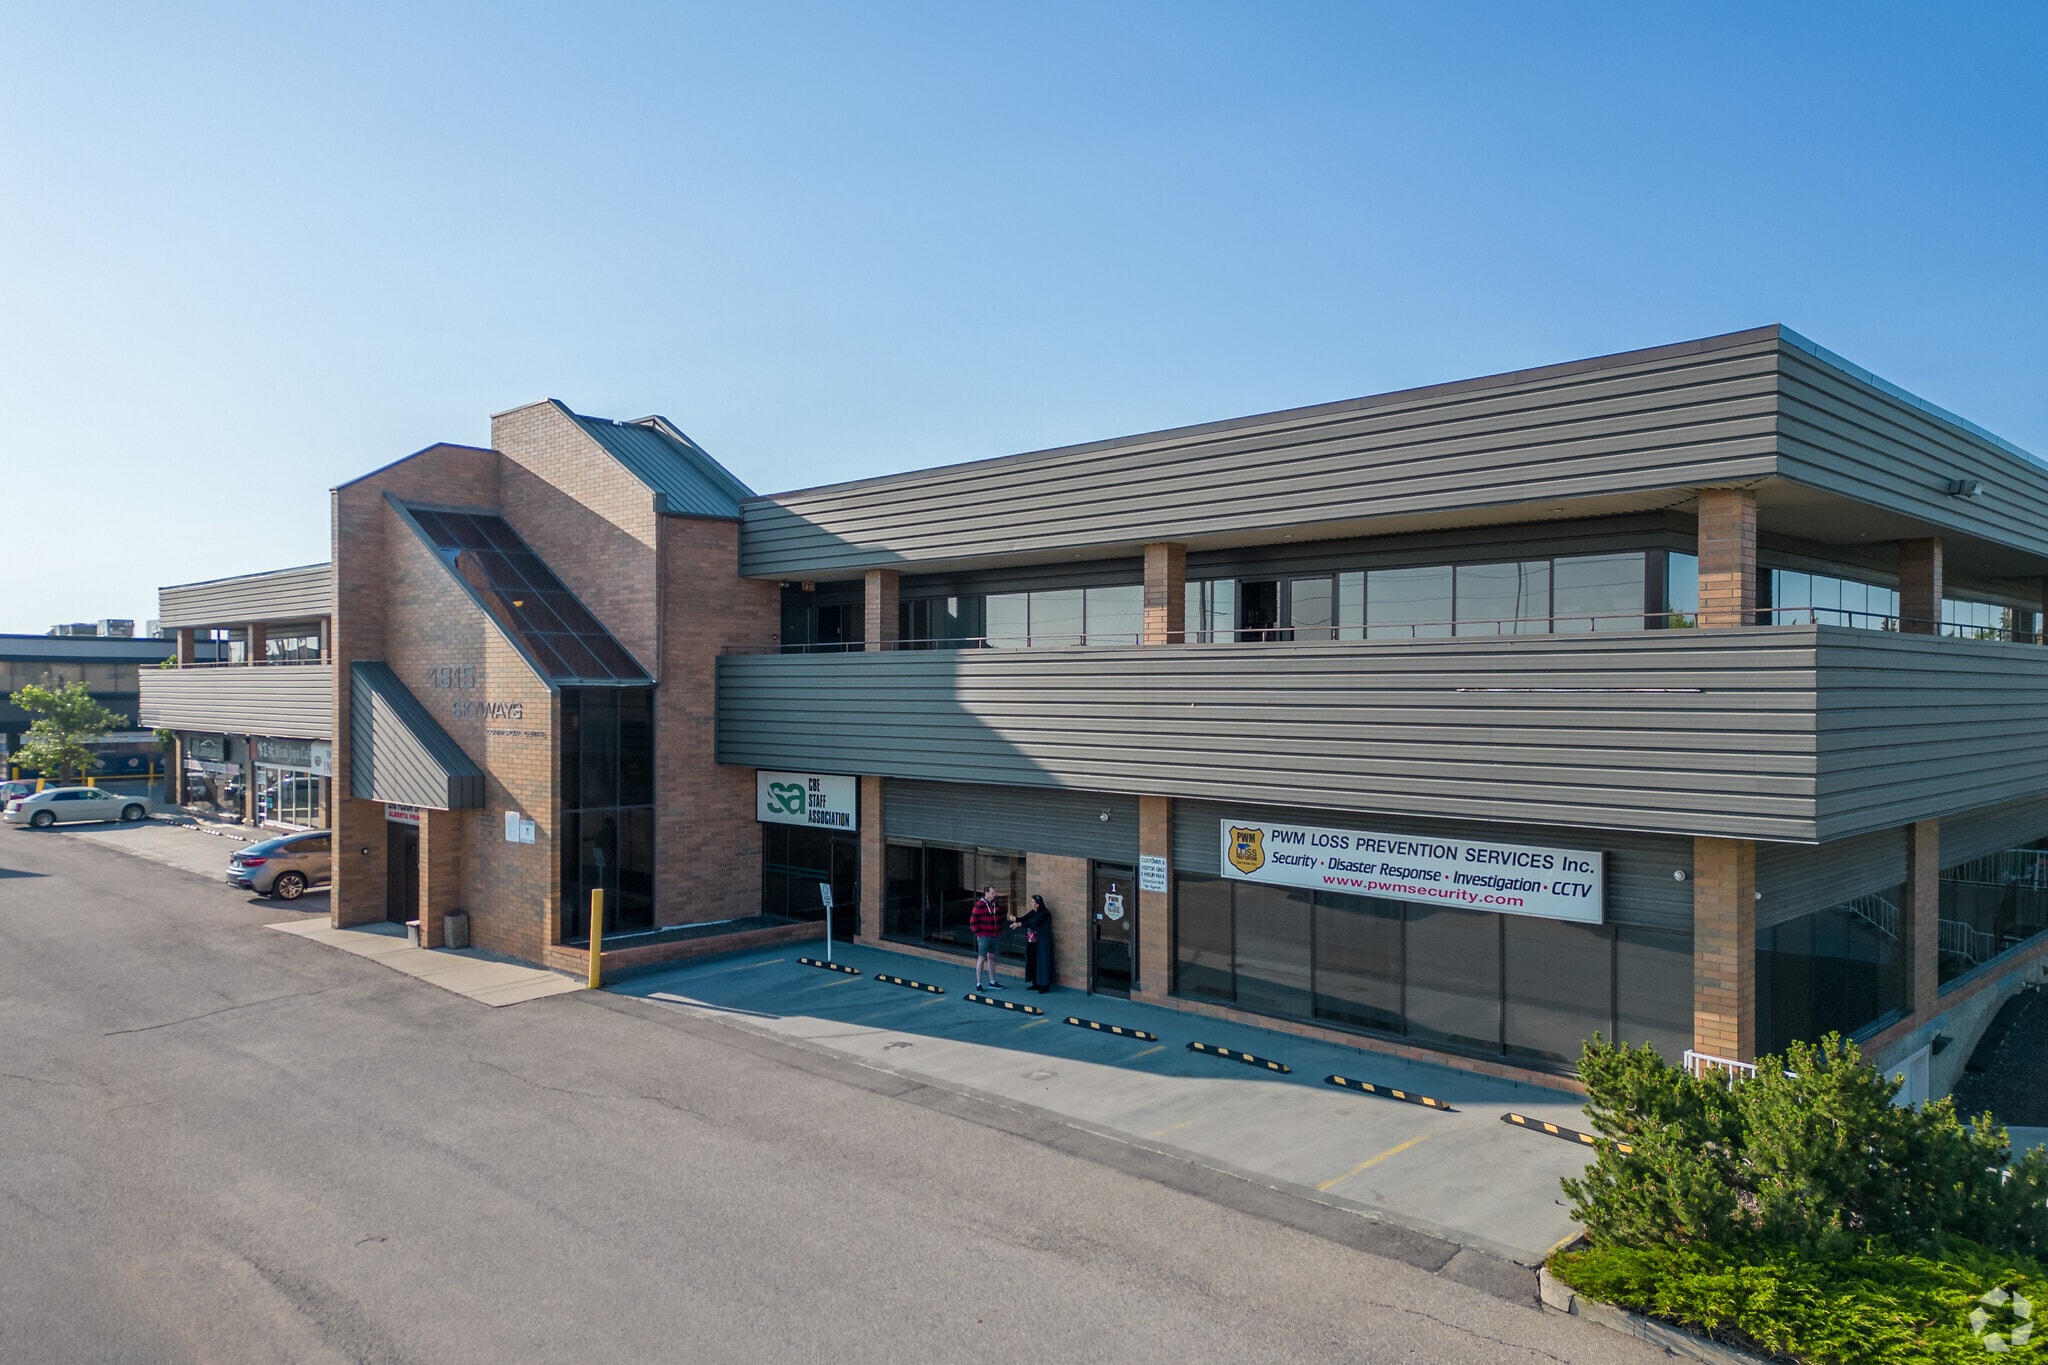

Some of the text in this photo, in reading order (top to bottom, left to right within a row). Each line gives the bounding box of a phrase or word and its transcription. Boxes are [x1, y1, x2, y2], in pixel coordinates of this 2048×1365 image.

[453, 700, 523, 719] SKYWAYS
[808, 778, 821, 792] CBE
[808, 794, 827, 808] STAFF
[808, 810, 850, 827] ASSOCIATION
[1236, 832, 1256, 844] PWM
[1271, 829, 1595, 874] PWM LOSS PREVENTION SERVICES Inc.
[1271, 851, 1593, 898] Security Disaster Response Investigation CCTV
[1111, 883, 1116, 892] 1
[1322, 875, 1524, 907] www.pwmsecurity.com
